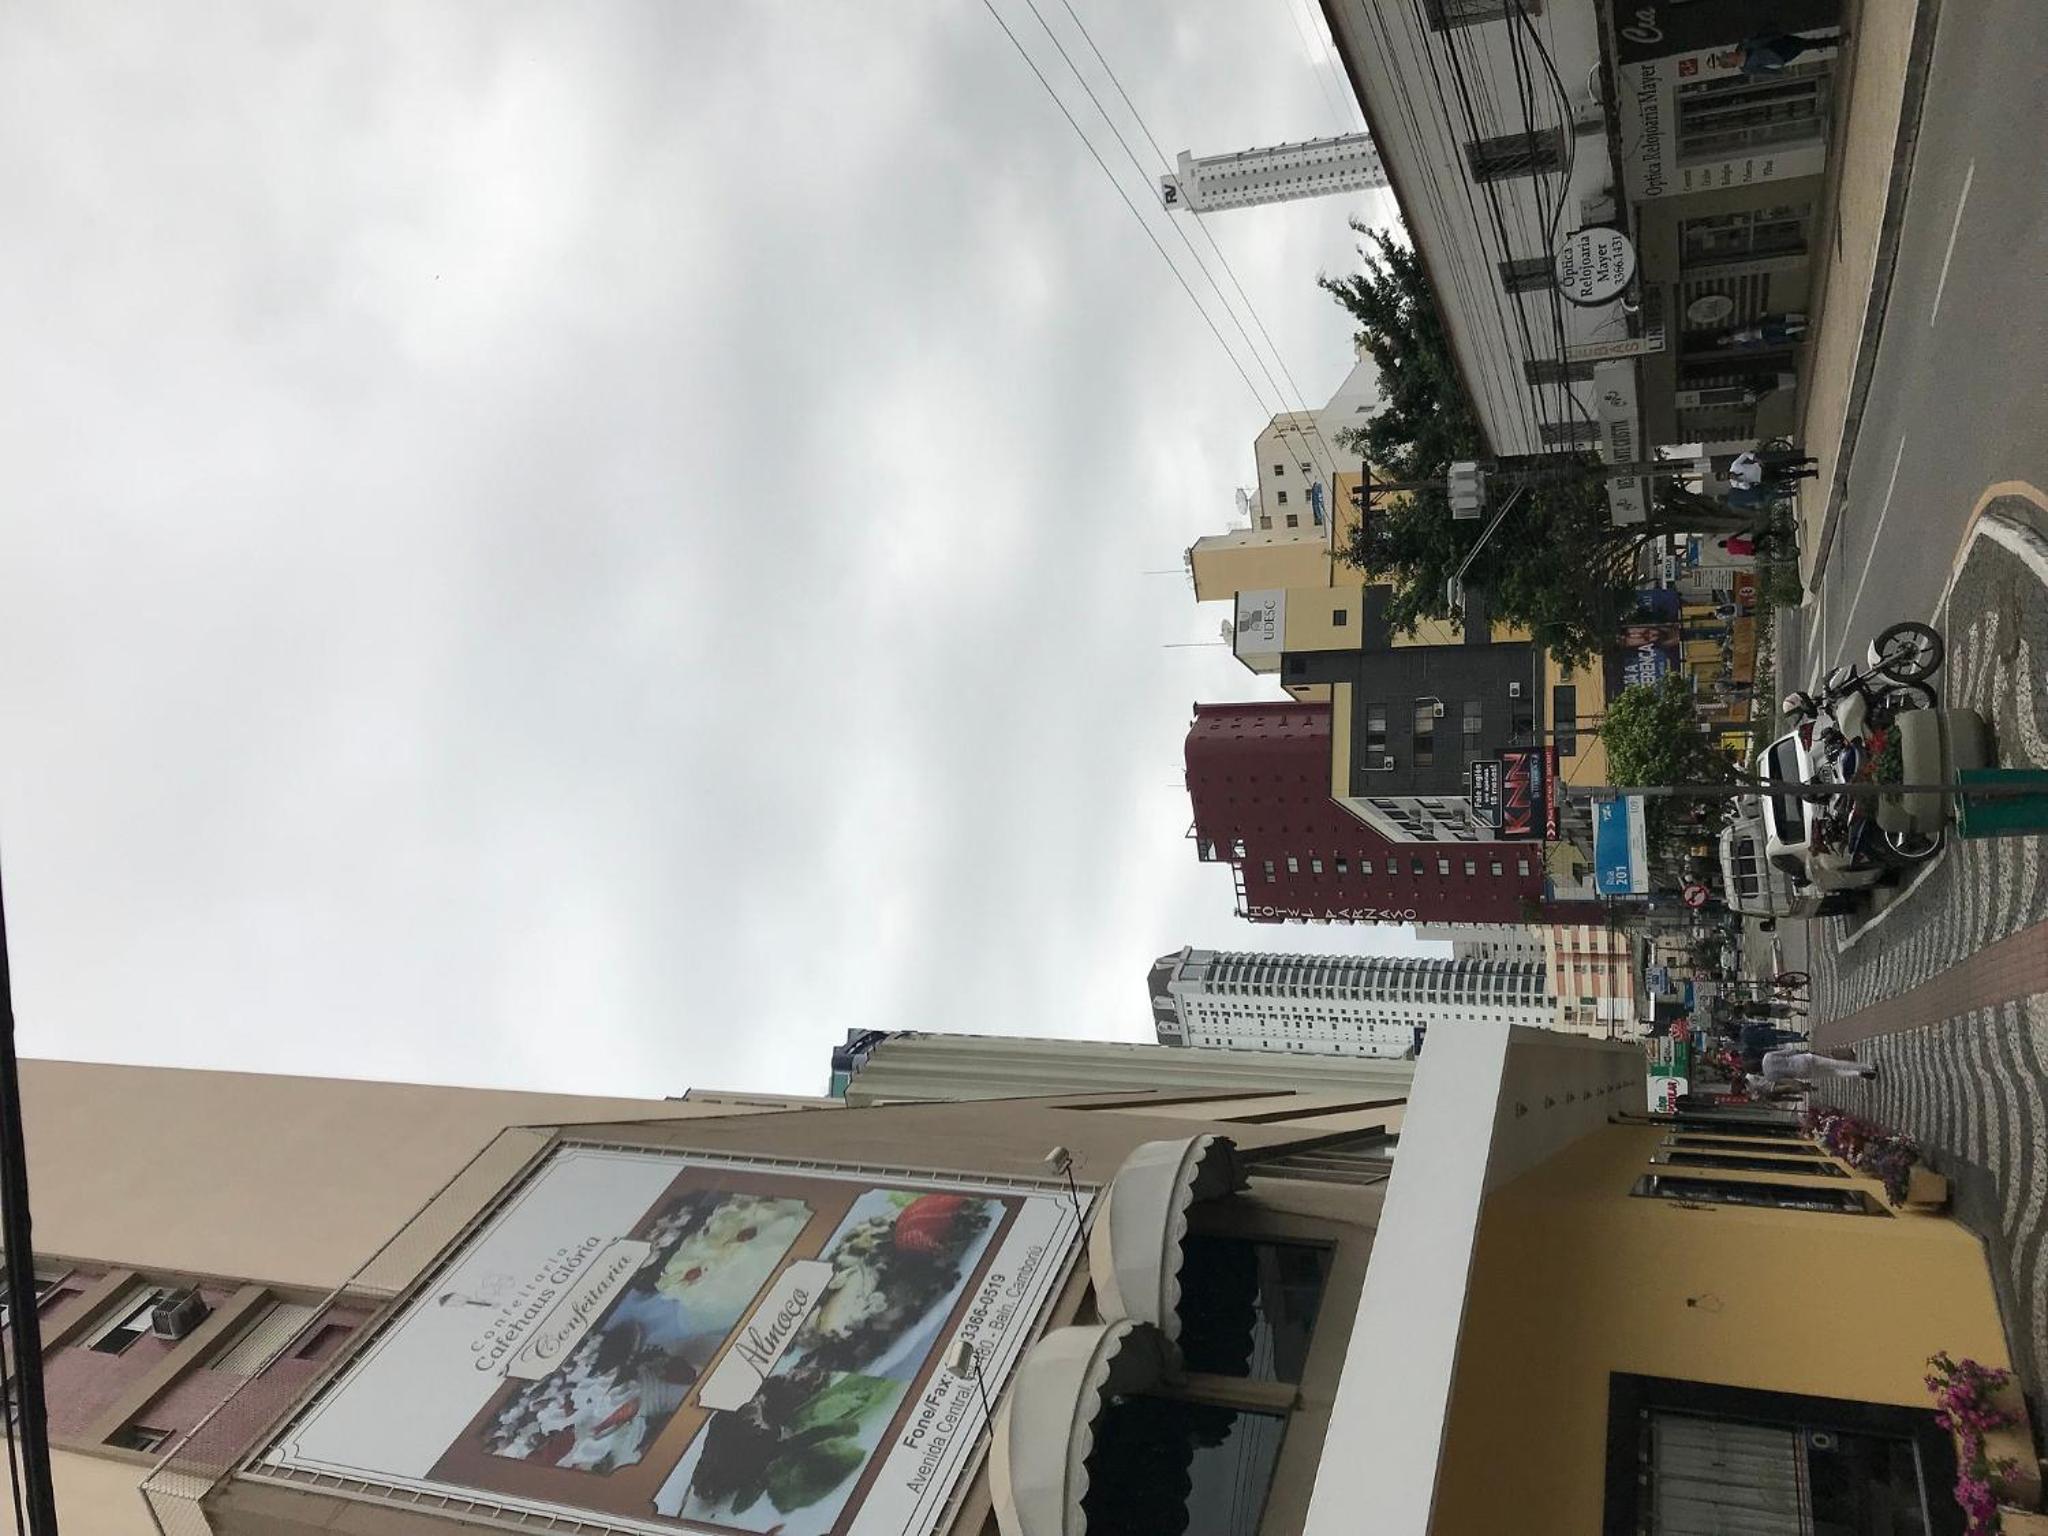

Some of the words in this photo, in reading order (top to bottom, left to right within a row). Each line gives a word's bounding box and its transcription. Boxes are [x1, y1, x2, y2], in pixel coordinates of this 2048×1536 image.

[1637, 64, 1663, 103] Mayer
[1640, 105, 1666, 161] Relojoaria
[1164, 184, 1177, 204] RV
[1578, 235, 1595, 297] Relojoaria
[1597, 244, 1611, 283] Mayer
[1263, 600, 1276, 640] UDESC
[1638, 643, 1656, 682] ERENÇA
[1474, 790, 1482, 807] Fale
[1504, 753, 1531, 834] KNN
[1606, 870, 1615, 885] Rua
[1616, 865, 1628, 885] 201
[1249, 905, 1314, 917] HOTEL
[1325, 907, 1417, 919] PARNASO
[470, 1247, 568, 1352] Confeitaria
[475, 1289, 555, 1371] Cafehaus
[550, 1236, 601, 1284] Glória
[521, 1256, 630, 1361] Confeitaria
[903, 1374, 954, 1451] Fone/Fax:
[960, 1274, 1006, 1341] 3366-0519
[906, 1437, 947, 1494] Avenida
